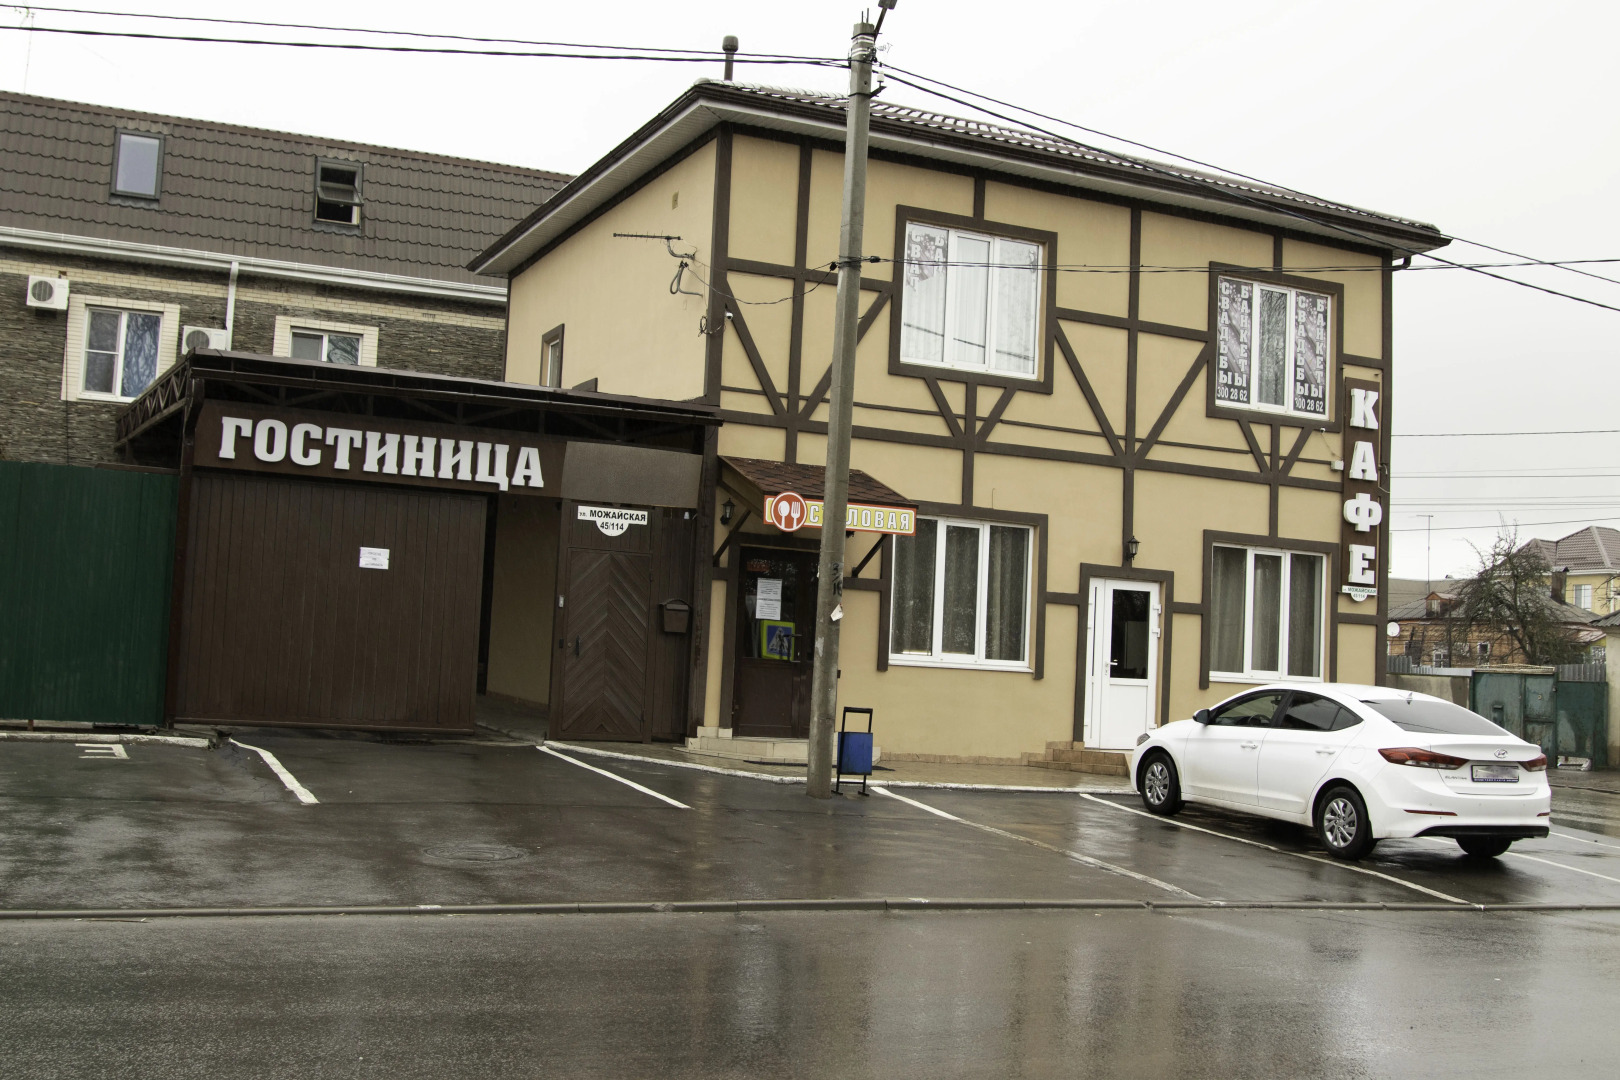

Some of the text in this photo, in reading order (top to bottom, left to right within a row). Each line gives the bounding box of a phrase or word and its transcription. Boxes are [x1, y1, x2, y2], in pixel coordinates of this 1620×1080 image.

[1219, 282, 1232, 385] СВАДЬБЫ
[1234, 285, 1249, 388] БАНКЕТЫ
[1296, 295, 1309, 396] СВАДЬБЫ
[1311, 298, 1326, 399] БАНКЕТЫ
[1230, 388, 1239, 400] 28
[1240, 390, 1248, 401] 62
[1307, 399, 1316, 411] 28
[1316, 401, 1324, 412] 62
[218, 416, 544, 492] ГОСТИНИЦА
[1343, 388, 1382, 585] КАФЕ
[589, 509, 646, 522] МОЖАЙСКАЯ
[600, 521, 624, 531] 45/114
[809, 505, 910, 531] СЛОВАЯ
